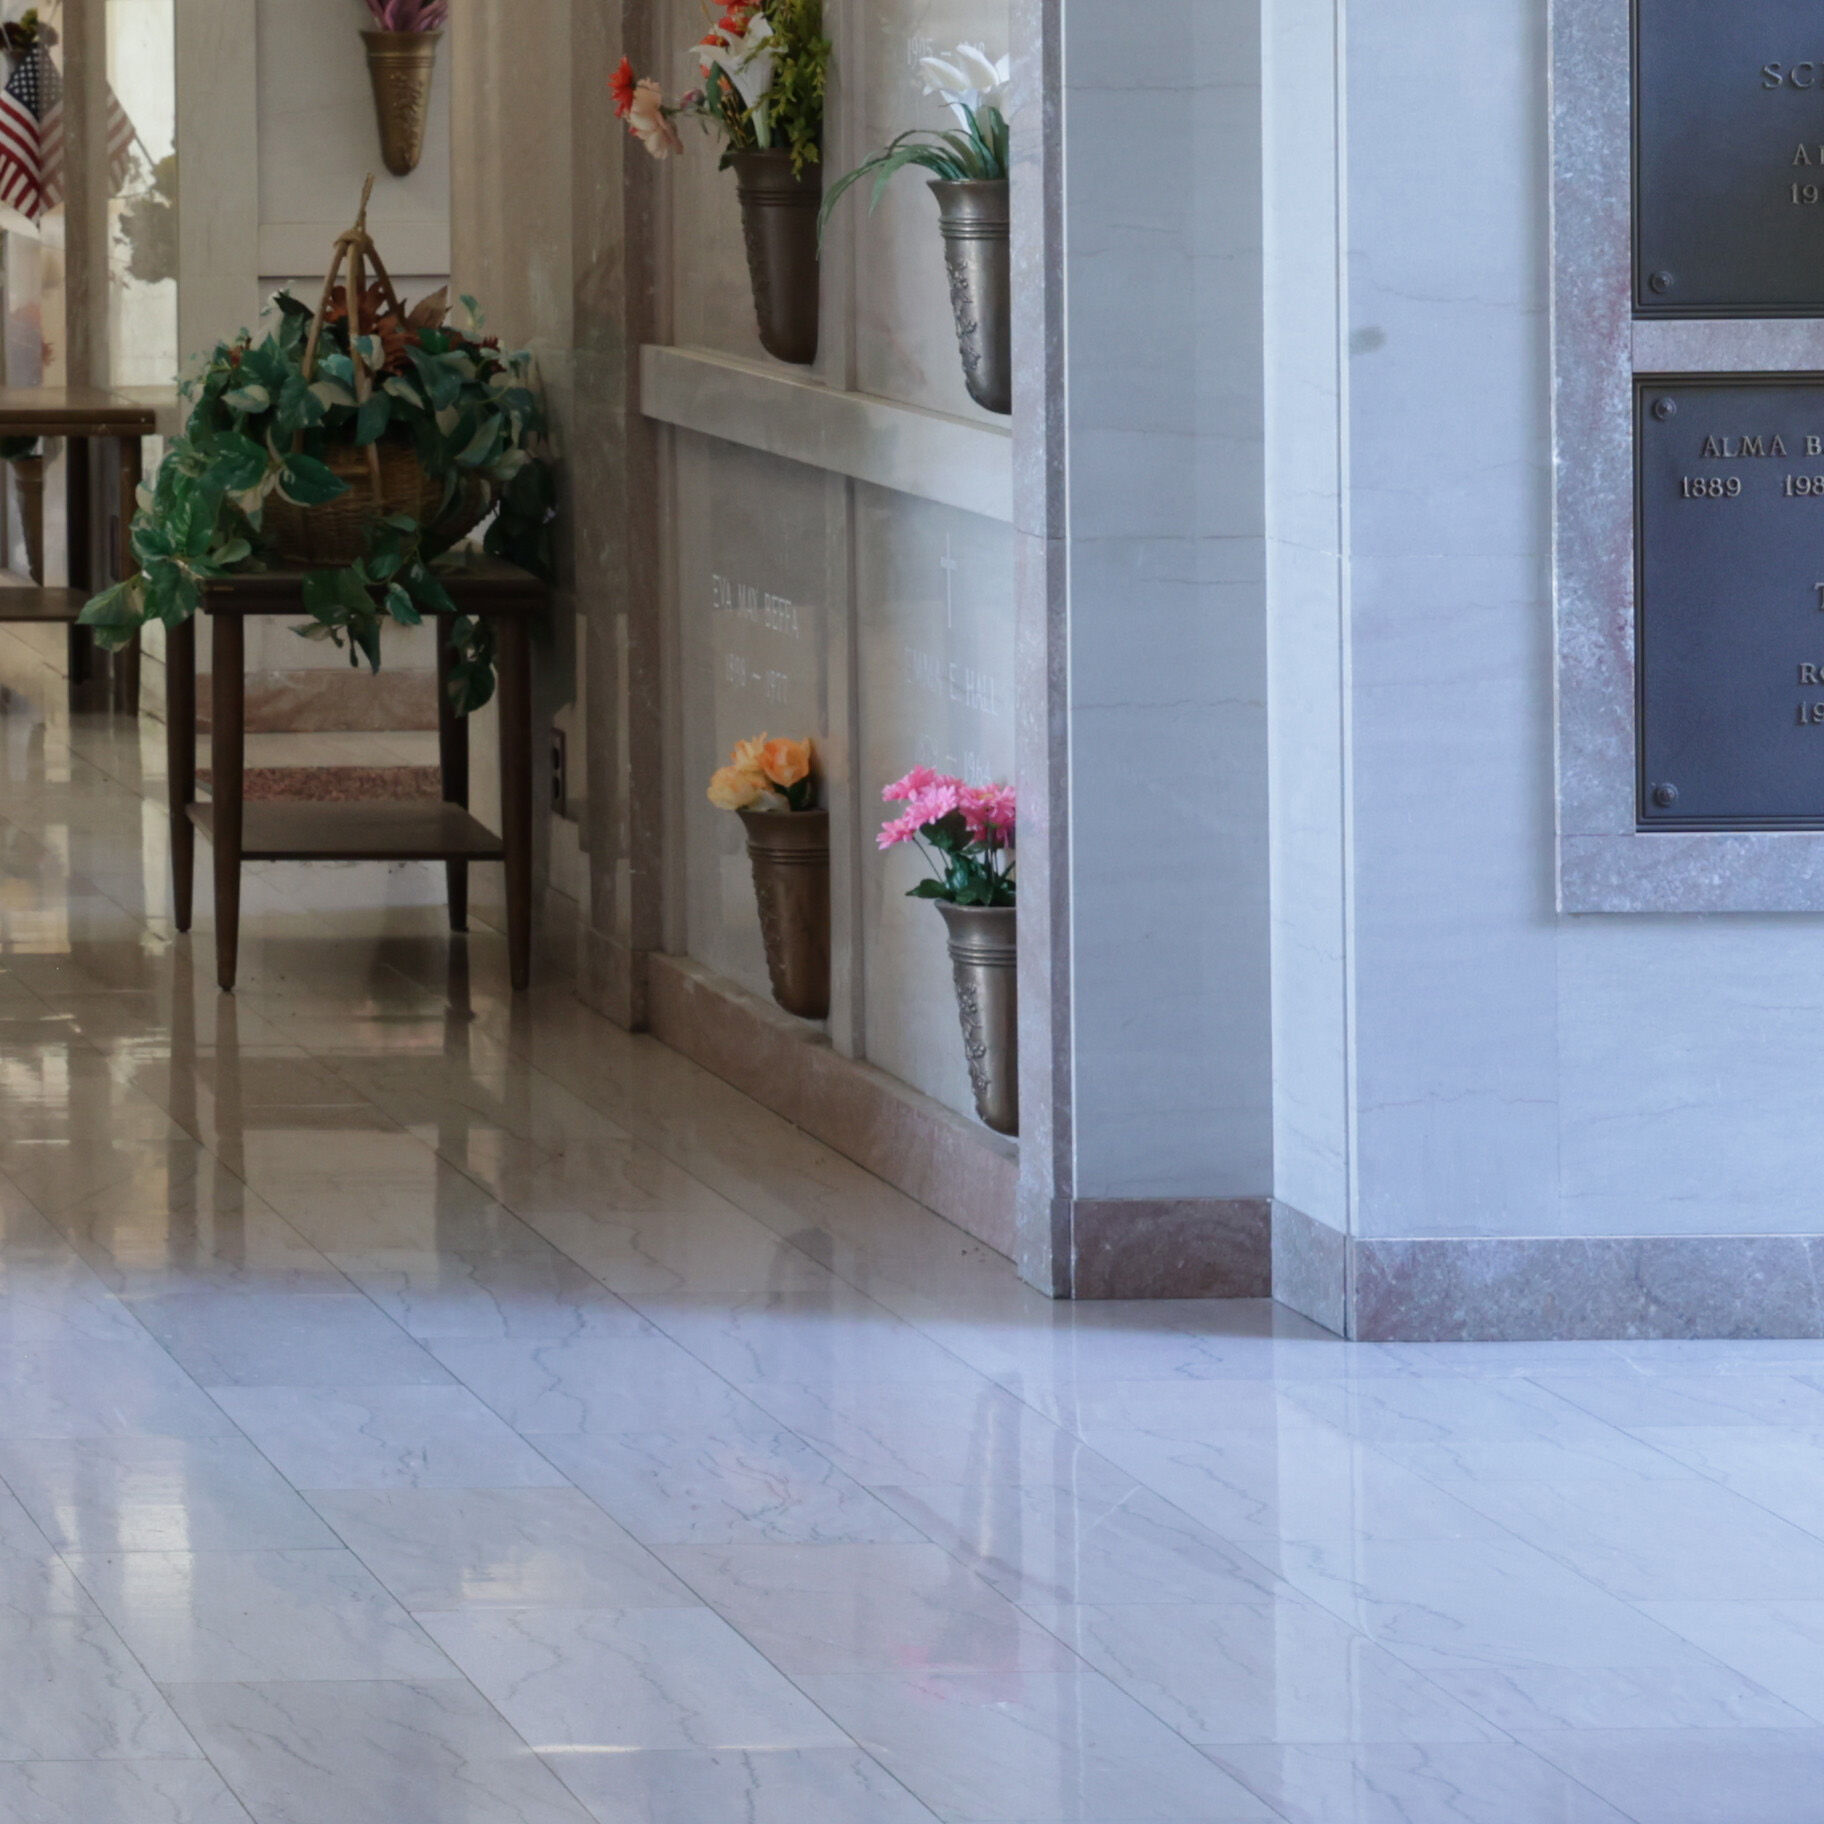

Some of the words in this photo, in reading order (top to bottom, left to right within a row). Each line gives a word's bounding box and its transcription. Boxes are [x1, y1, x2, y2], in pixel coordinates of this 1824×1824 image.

[1762, 60, 1824, 90] SC
[1701, 434, 1788, 458] ALMA
[1681, 475, 1742, 498] 1889
[711, 572, 733, 613] EVA
